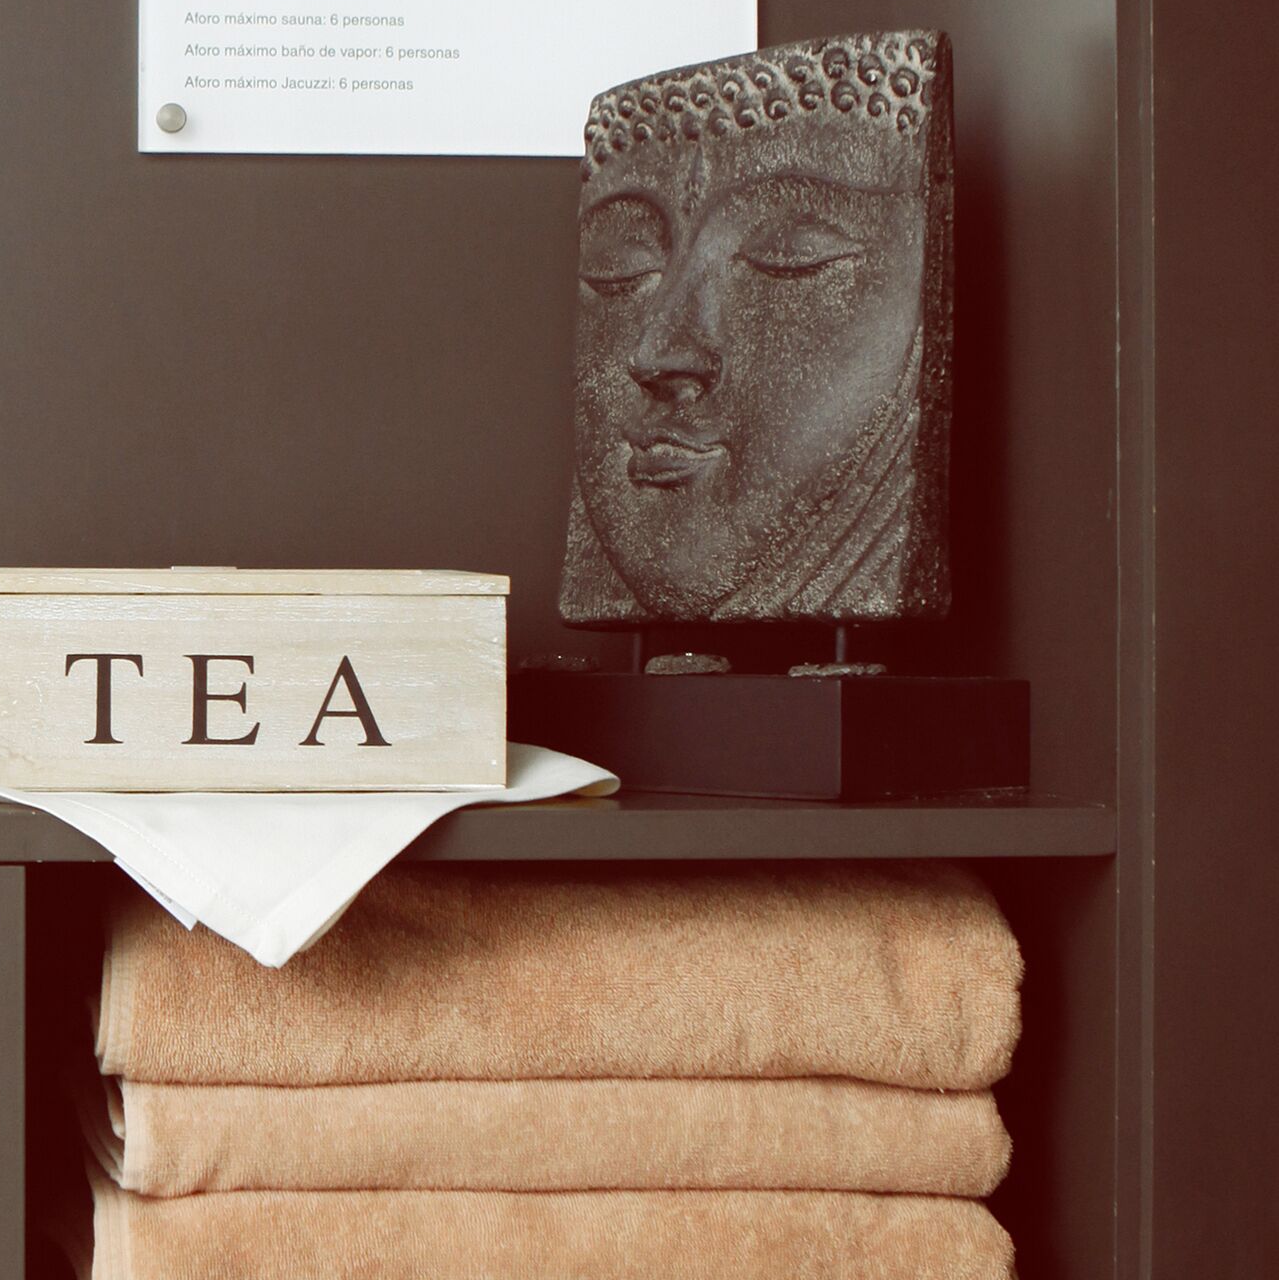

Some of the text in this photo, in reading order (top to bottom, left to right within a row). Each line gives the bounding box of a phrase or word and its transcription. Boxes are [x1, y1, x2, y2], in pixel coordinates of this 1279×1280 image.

[184, 10, 404, 28] Aforo máximo sauna: 6 personas
[184, 42, 460, 61] Aforo máximo baño de vapor: 6 personas
[184, 74, 413, 92] Aforo máximo Jacuzzi: 6 personas
[64, 653, 392, 746] TEA
